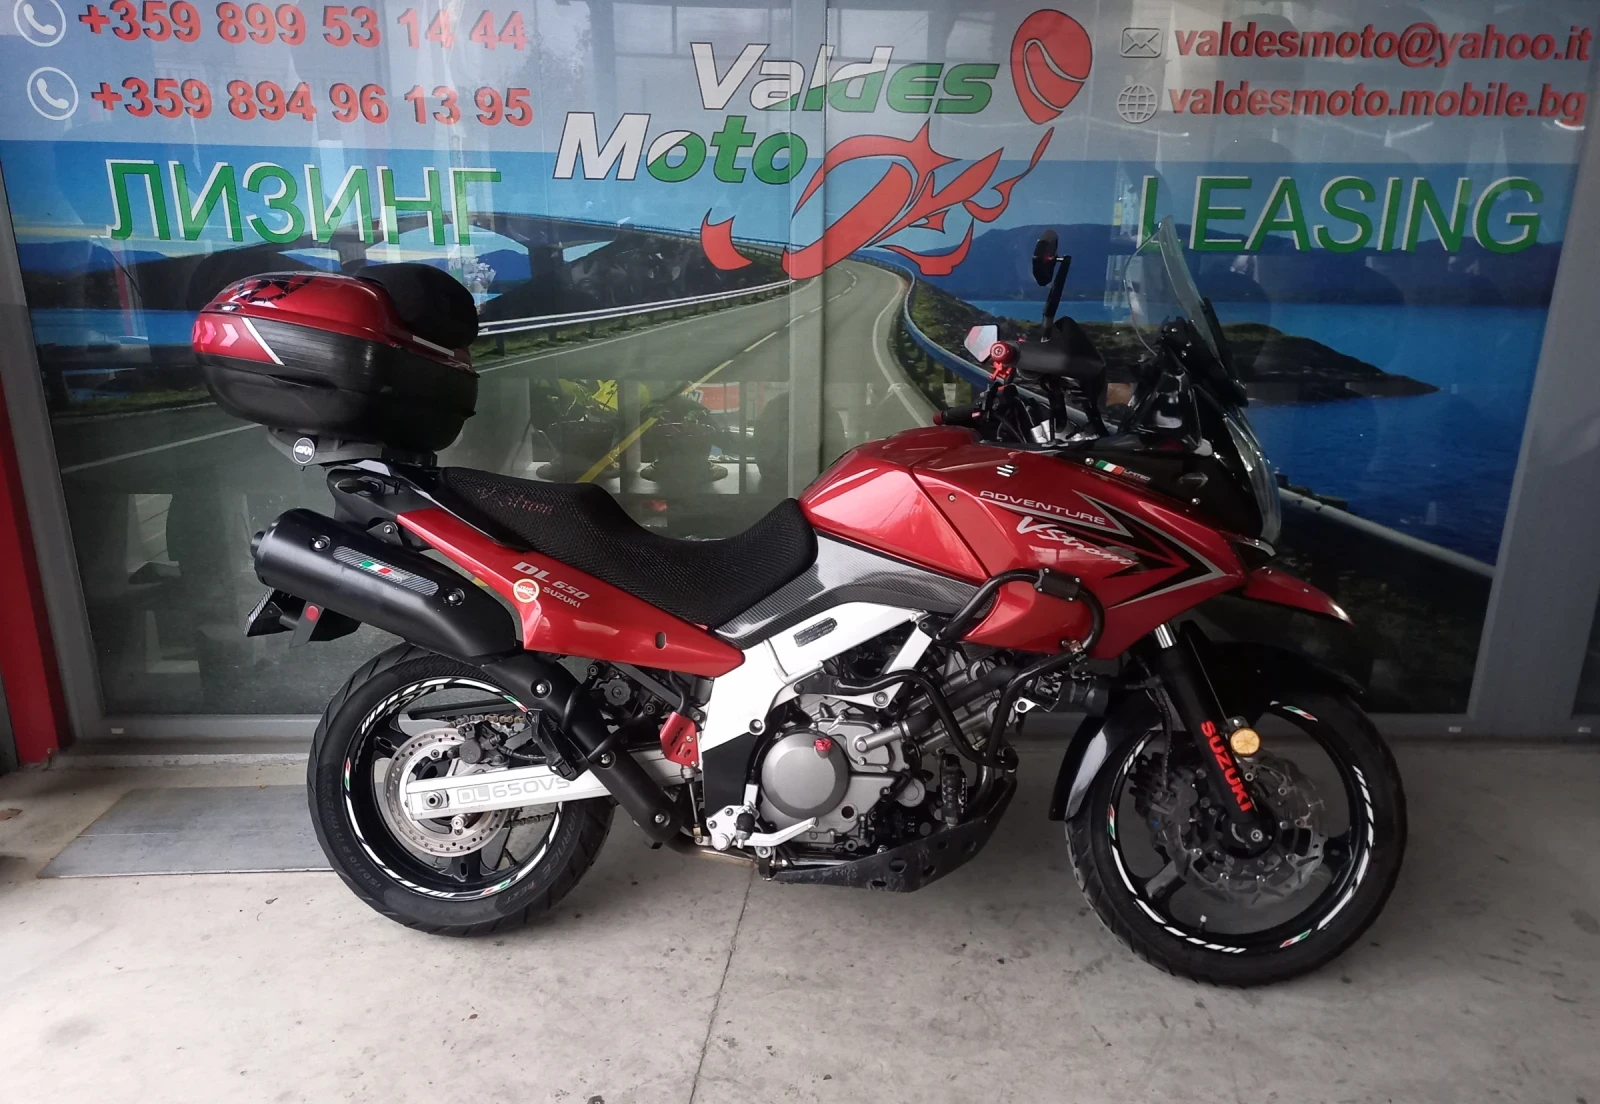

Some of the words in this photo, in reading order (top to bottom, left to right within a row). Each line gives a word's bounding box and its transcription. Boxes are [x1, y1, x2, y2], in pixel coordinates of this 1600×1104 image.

[78, 1, 201, 42] +359
[217, 3, 306, 46] 899
[322, 6, 381, 48] 53
[397, 8, 454, 50] 14
[470, 10, 529, 51] 44
[1175, 21, 1591, 68] valdesmoto@yahoo.it
[92, 77, 213, 118] +359
[227, 79, 317, 121] 894
[331, 82, 389, 124] 96
[404, 84, 461, 126] 13
[474, 86, 533, 127] 95
[690, 42, 999, 113] Valdes
[1168, 80, 1587, 126] valdesmoto.mobile.bg
[553, 112, 808, 184] Moto
[105, 159, 501, 246] ЛИЗИНГ
[1137, 175, 1543, 254] LEASING
[980, 490, 1106, 525] ADVENTURE
[512, 561, 550, 583] DL
[552, 580, 590, 600] 650
[542, 586, 581, 609] SUZUKI
[1201, 720, 1253, 812] SUZUKI
